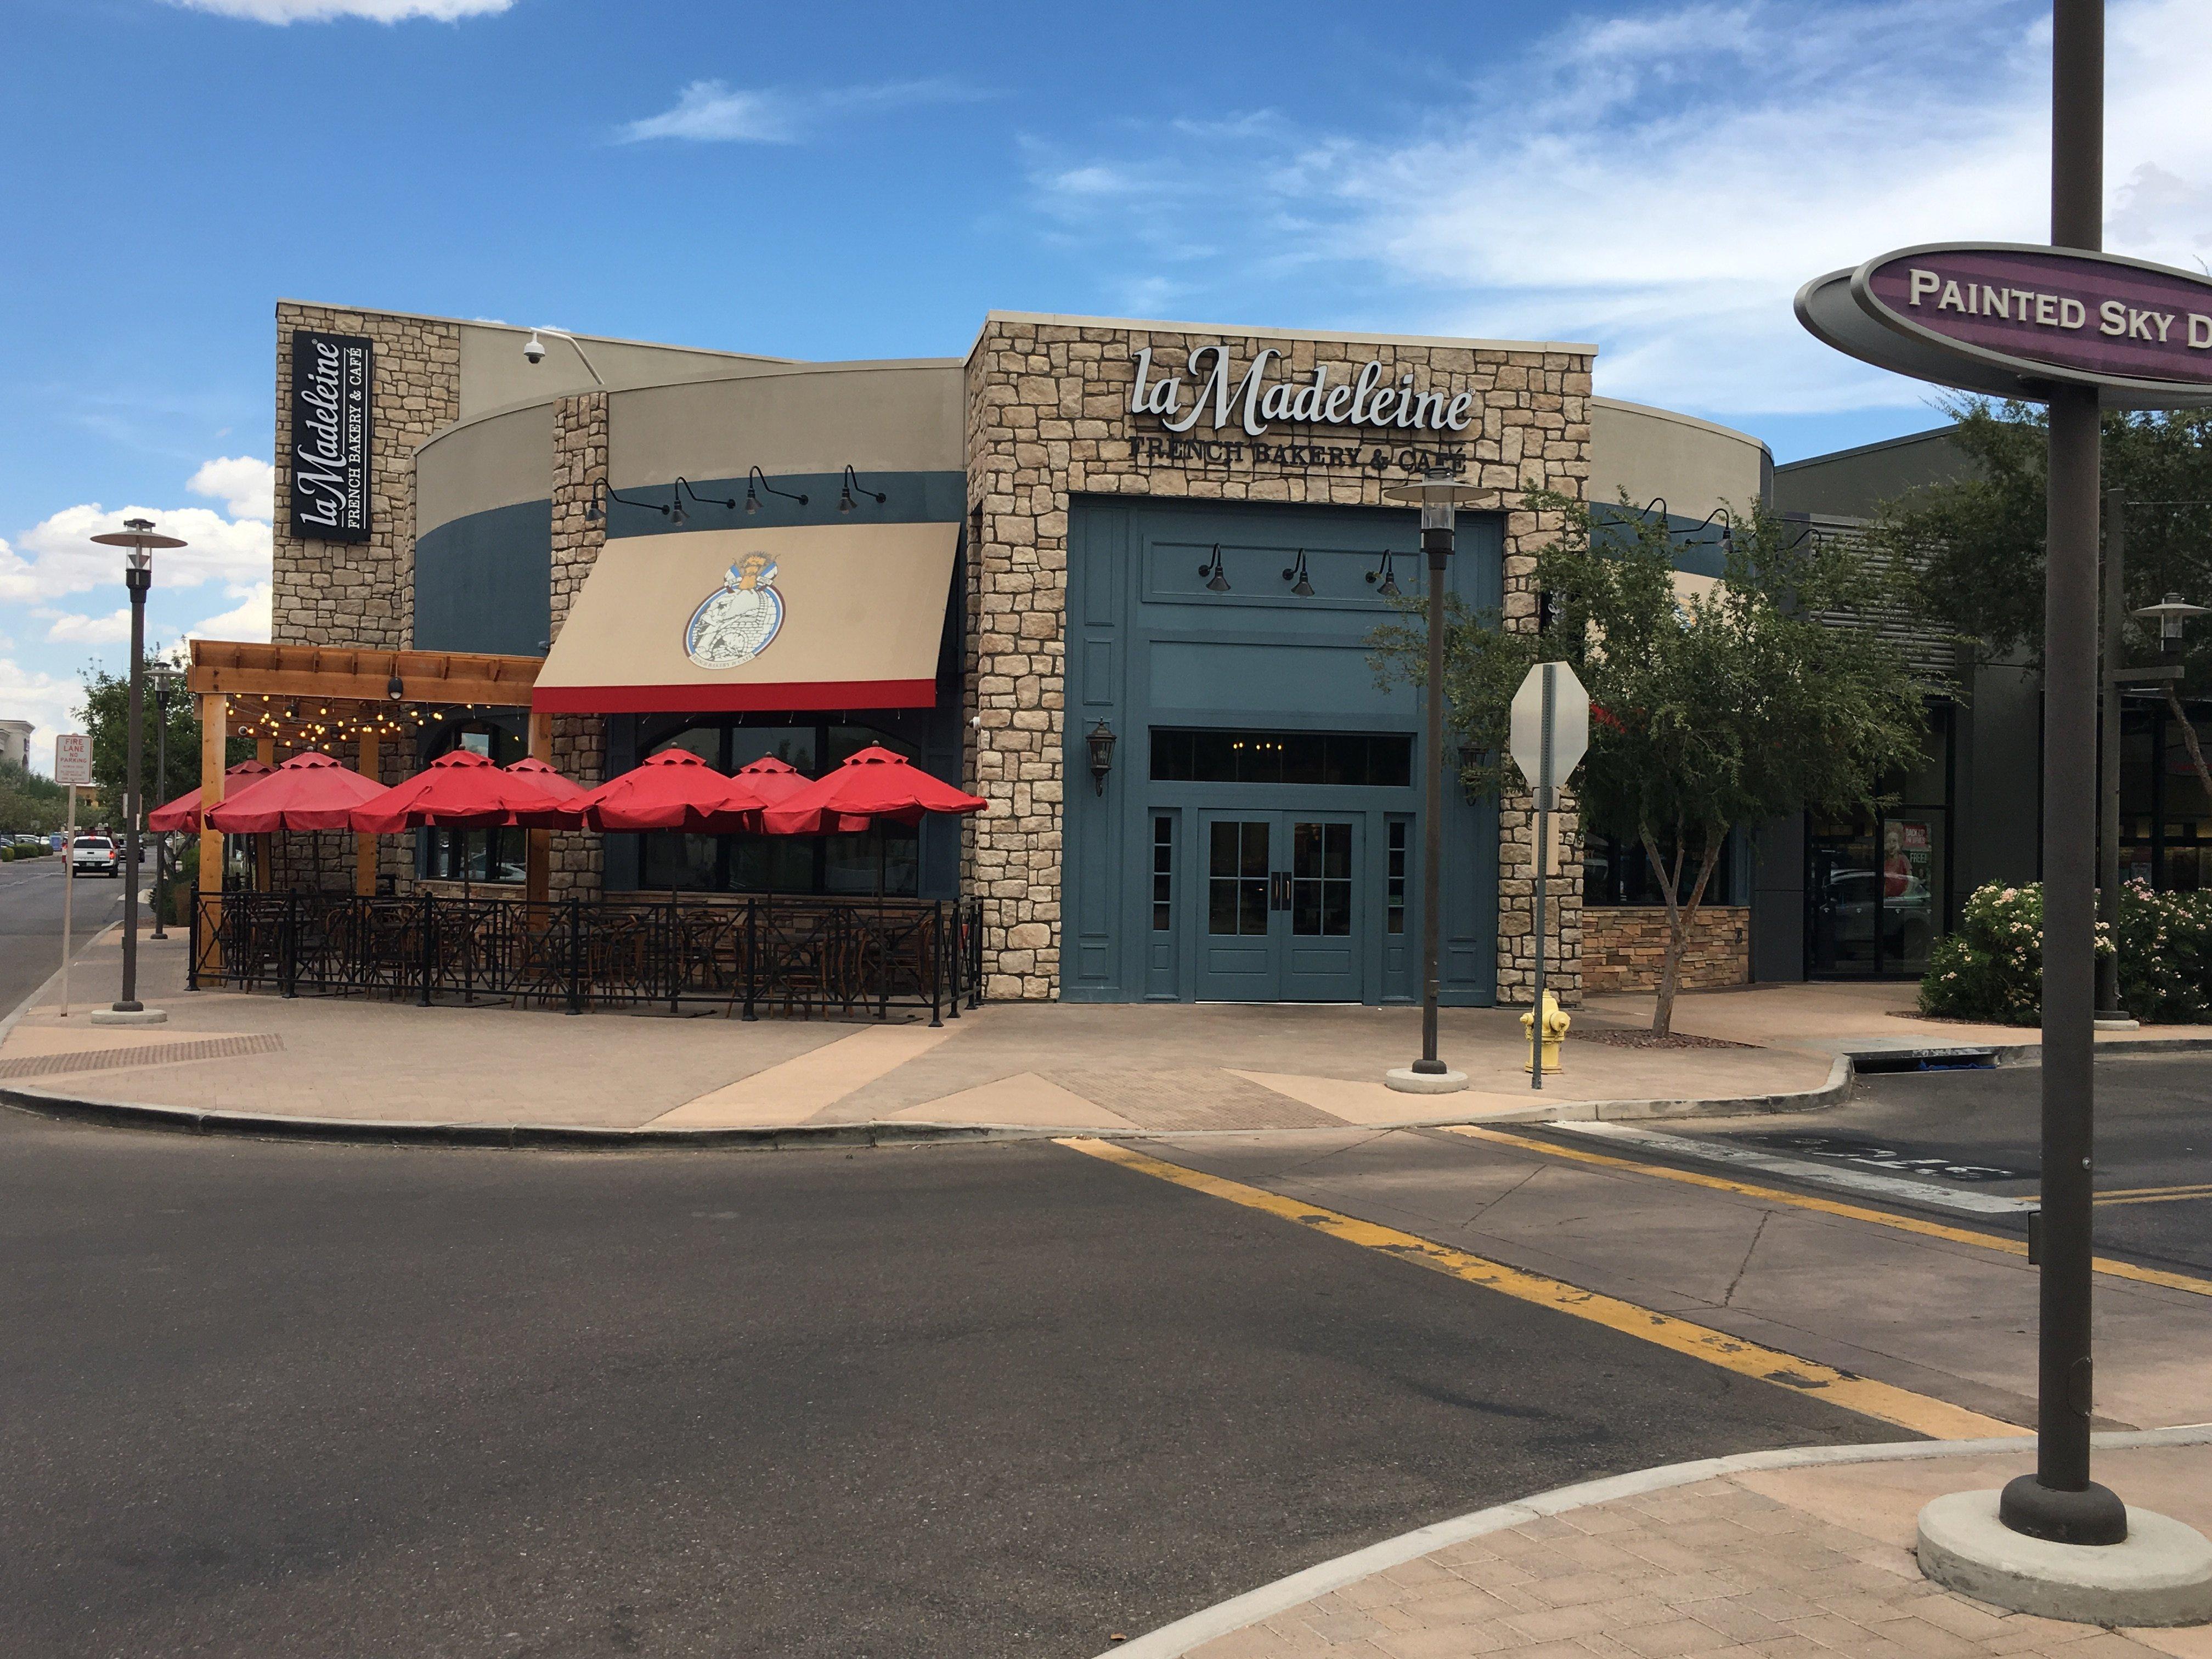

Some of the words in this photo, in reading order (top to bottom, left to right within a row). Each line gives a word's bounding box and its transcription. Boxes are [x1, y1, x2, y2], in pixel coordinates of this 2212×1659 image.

[1909, 268, 2085, 329] PAINTED
[2100, 301, 2175, 342] SKY
[346, 347, 362, 385] CAFÉ
[349, 390, 362, 401] &
[1131, 347, 1182, 415] la
[1162, 345, 1475, 436] Madeleine
[297, 342, 347, 510] Madeleine
[348, 404, 362, 464] BAKERY
[1128, 436, 1244, 462] FRENCH
[1254, 442, 1362, 467] BAKERY
[1371, 448, 1389, 470] &
[300, 499, 338, 527] la
[348, 468, 360, 529] FRENCH
